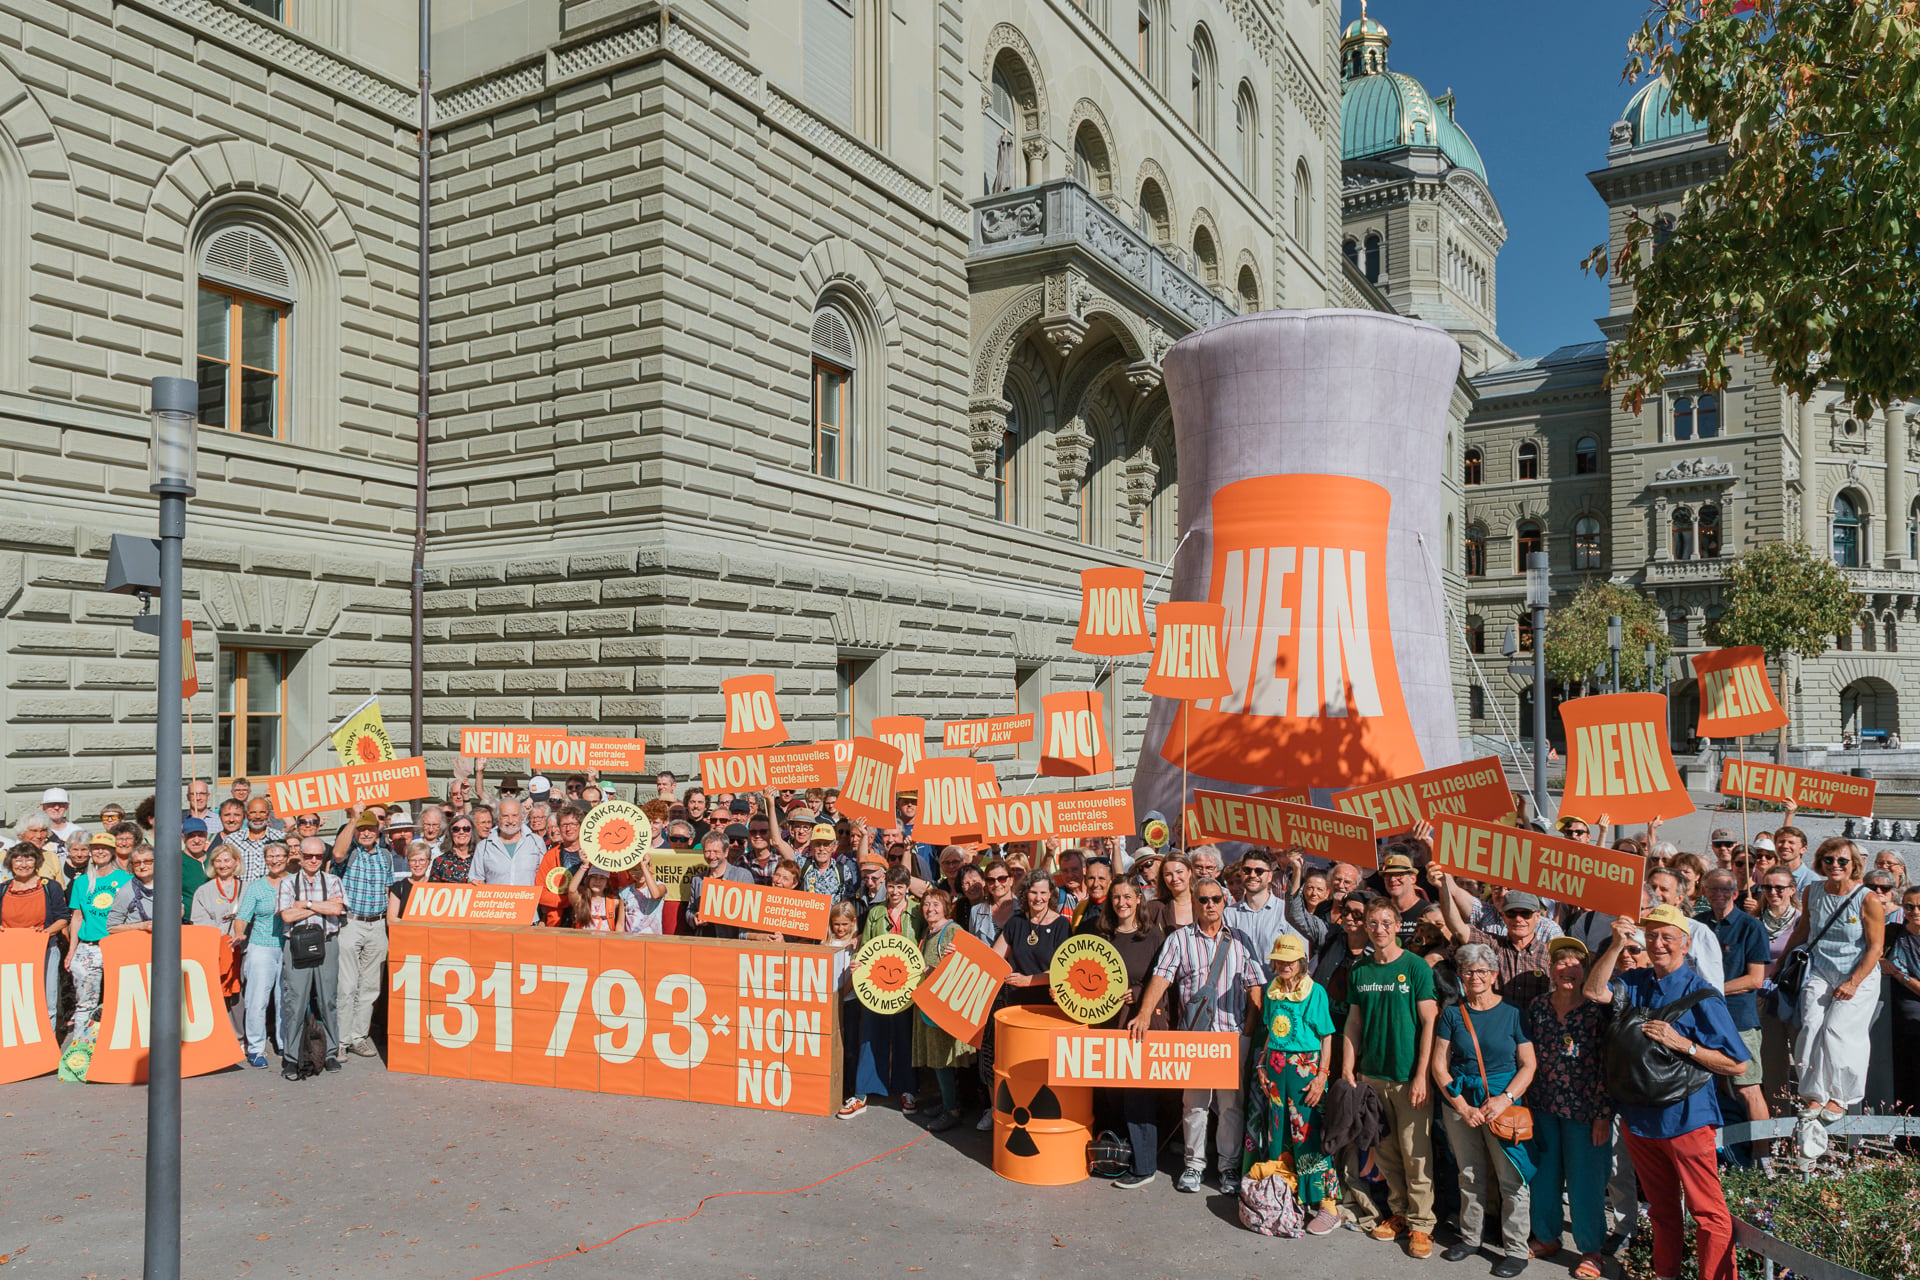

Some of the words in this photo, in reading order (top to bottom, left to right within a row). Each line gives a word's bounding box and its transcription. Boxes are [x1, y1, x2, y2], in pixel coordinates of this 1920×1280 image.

[1085, 587, 1142, 636] NON
[1195, 546, 1384, 718] NEIN
[1157, 624, 1220, 678] NEIN
[1704, 665, 1772, 720] NEIN
[731, 690, 775, 733] NO
[465, 731, 513, 754] NEIN
[947, 722, 988, 746] NEIN
[992, 723, 1002, 731] zu
[1003, 719, 1031, 729] neuen
[991, 731, 1011, 742] AKW
[1048, 710, 1100, 758] NO
[517, 744, 530, 754] AK
[535, 739, 586, 766] NON
[605, 742, 640, 751] nouvelles
[589, 750, 626, 759] centrales
[589, 758, 629, 767] nucléaires
[1576, 721, 1671, 796] NEIN
[705, 754, 767, 789] NON
[769, 755, 785, 763] aux
[787, 751, 829, 761] nouvelles
[770, 763, 814, 774] centrales
[772, 774, 820, 785] nucléaires
[845, 755, 894, 812] NEIN
[1420, 781, 1442, 798] zu
[1443, 768, 1499, 794] neuen
[1726, 763, 1796, 798] NEIN
[1800, 776, 1821, 790] zu
[1823, 779, 1869, 797] neuen
[275, 773, 350, 812] NEIN
[352, 774, 370, 785] zu
[373, 765, 420, 782] neuen
[356, 784, 389, 801] AKW
[922, 777, 978, 825] NON
[1798, 789, 1833, 806] AKW
[985, 800, 1054, 837] NON
[1057, 801, 1075, 810] aux
[1077, 797, 1127, 808] nouvelles
[1058, 810, 1108, 821] centrales
[1200, 796, 1283, 843] NEIN
[1286, 812, 1307, 828] zu
[1311, 815, 1368, 841] neuen
[1427, 795, 1466, 819] AKW
[584, 804, 643, 843] ATOMKRAFT?
[1059, 821, 1114, 833] nucléaires
[594, 854, 622, 868] NEIN
[624, 831, 648, 865] DANKE
[1290, 829, 1329, 852] AKW
[1439, 821, 1532, 884] NEIN
[1539, 847, 1562, 867] zu
[1567, 853, 1634, 886] neuen
[655, 865, 682, 875] NEUE
[655, 875, 679, 884] NEIN
[1537, 868, 1586, 898] AKW
[409, 887, 472, 917] NON
[493, 890, 535, 900] nouvelles
[470, 909, 517, 919] nucléaires
[473, 900, 515, 909] centrales
[704, 884, 762, 923] NON
[766, 894, 782, 905] aux
[784, 896, 825, 911] nouvelles
[765, 905, 807, 919] centrales
[763, 916, 809, 931] nucléaires
[859, 938, 921, 970] NUCLEAIRE?
[1057, 939, 1123, 984] ATOMKRAFT?
[739, 953, 828, 1003] NEIN
[929, 952, 997, 1027] NON
[109, 958, 214, 1050] NO
[857, 982, 879, 1007] NON
[880, 987, 914, 1010] MERCI
[1054, 983, 1078, 1013] NEIN
[1079, 994, 1120, 1019] DANKE
[739, 1006, 821, 1057] NON
[1056, 1036, 1142, 1079] NEIN
[1149, 1042, 1170, 1058] zu
[1174, 1042, 1231, 1059] neuen
[1149, 1061, 1191, 1080] AKW
[737, 1058, 792, 1107] NO
